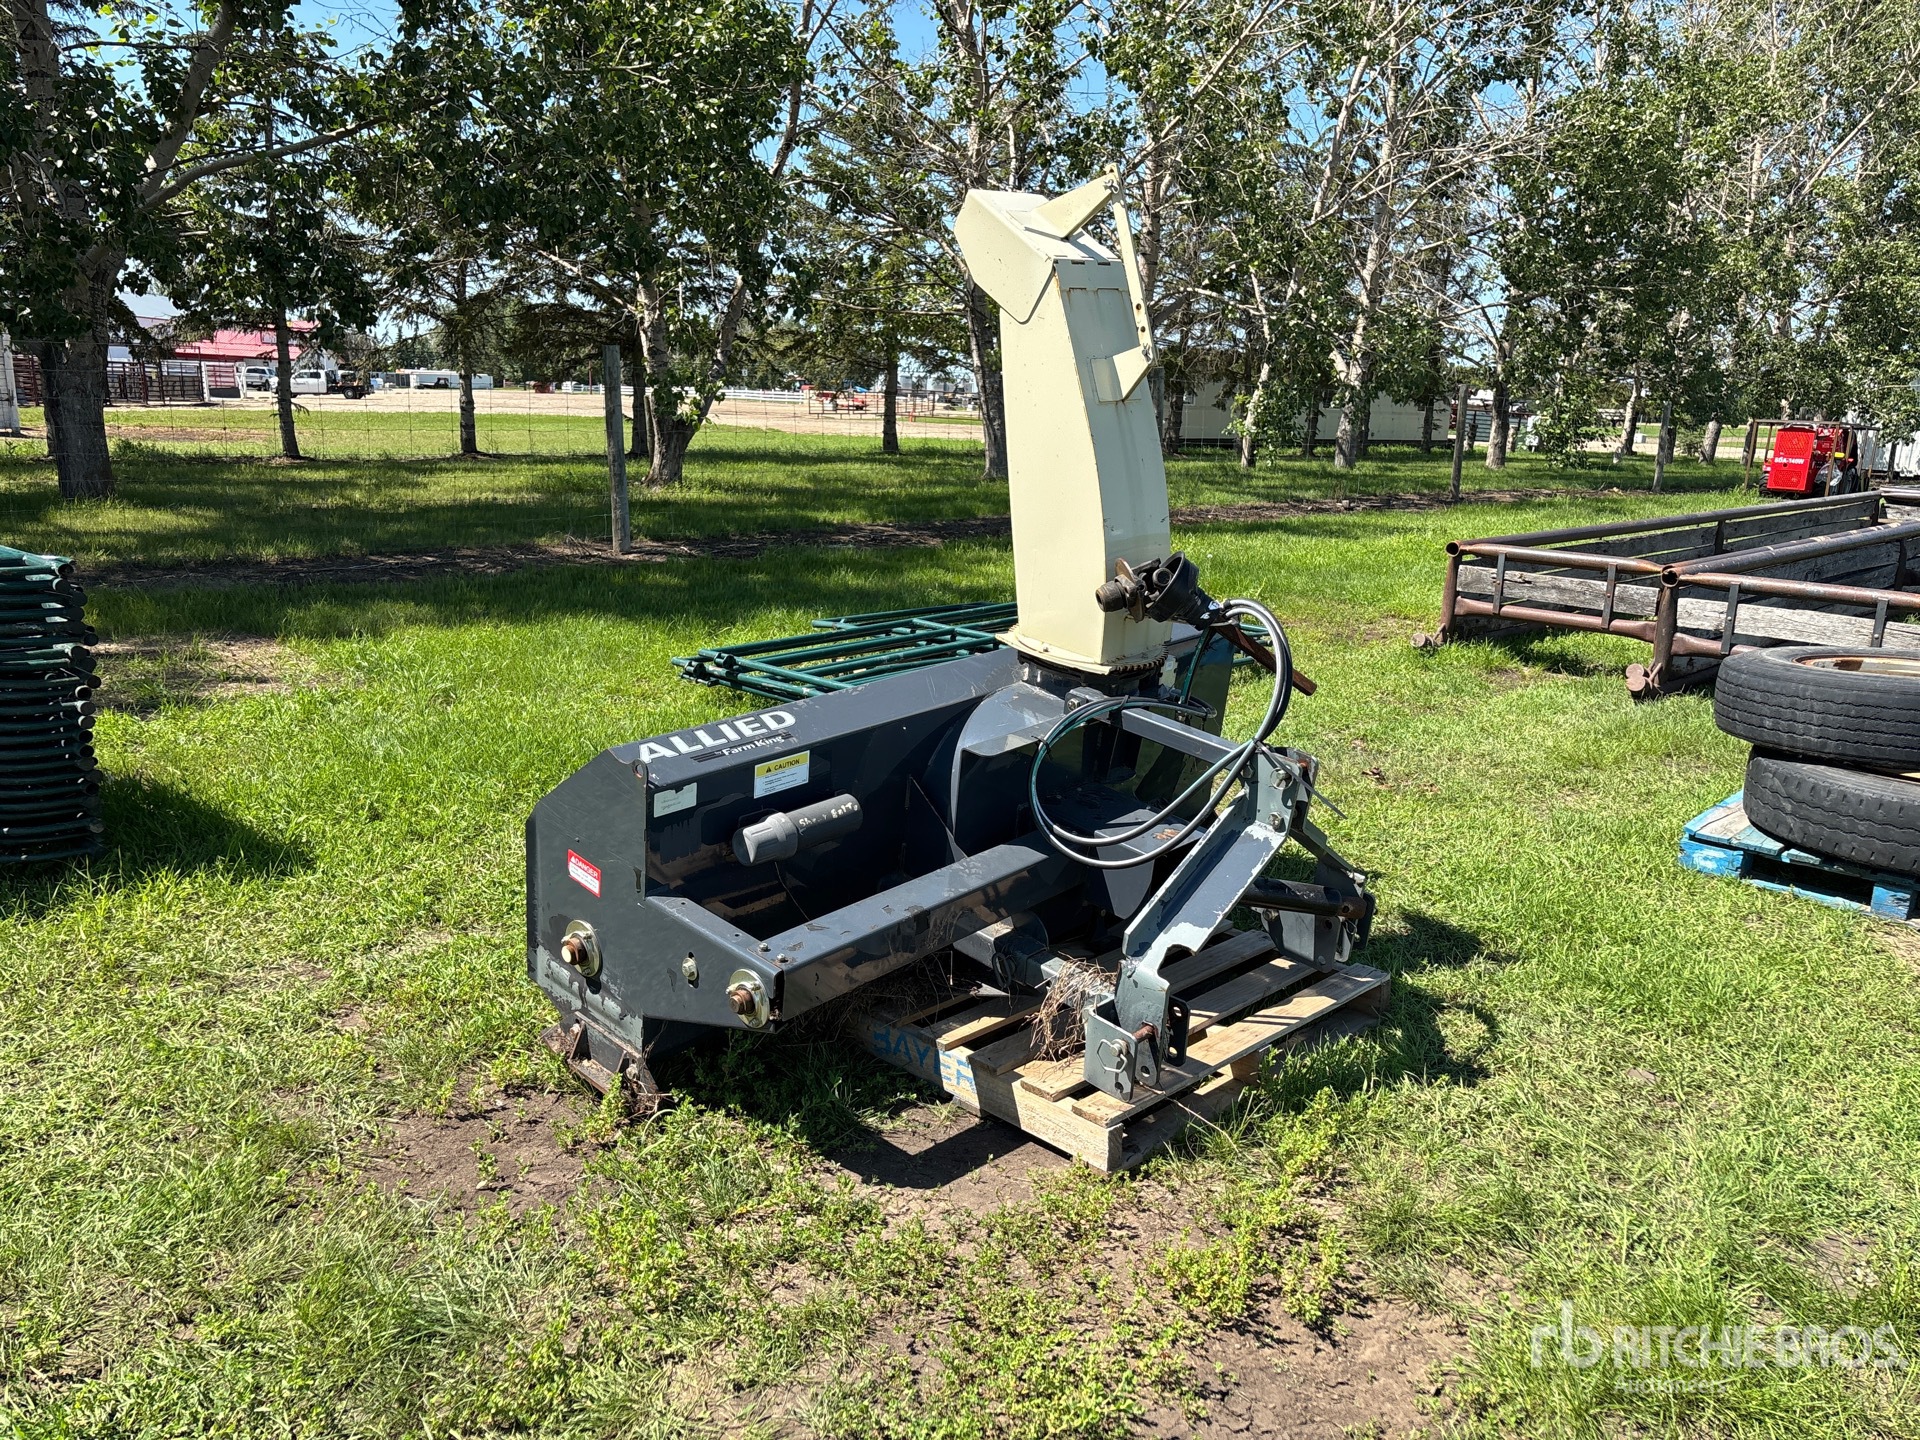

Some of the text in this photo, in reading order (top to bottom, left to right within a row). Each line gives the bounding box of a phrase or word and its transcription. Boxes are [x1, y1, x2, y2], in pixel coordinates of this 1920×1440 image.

[639, 710, 796, 764] ALLIED
[722, 745, 755, 756] Farm
[754, 736, 784, 748] King
[774, 759, 800, 771] CAUTION
[575, 857, 599, 879] DANGER
[873, 1024, 977, 1092] BAYER
